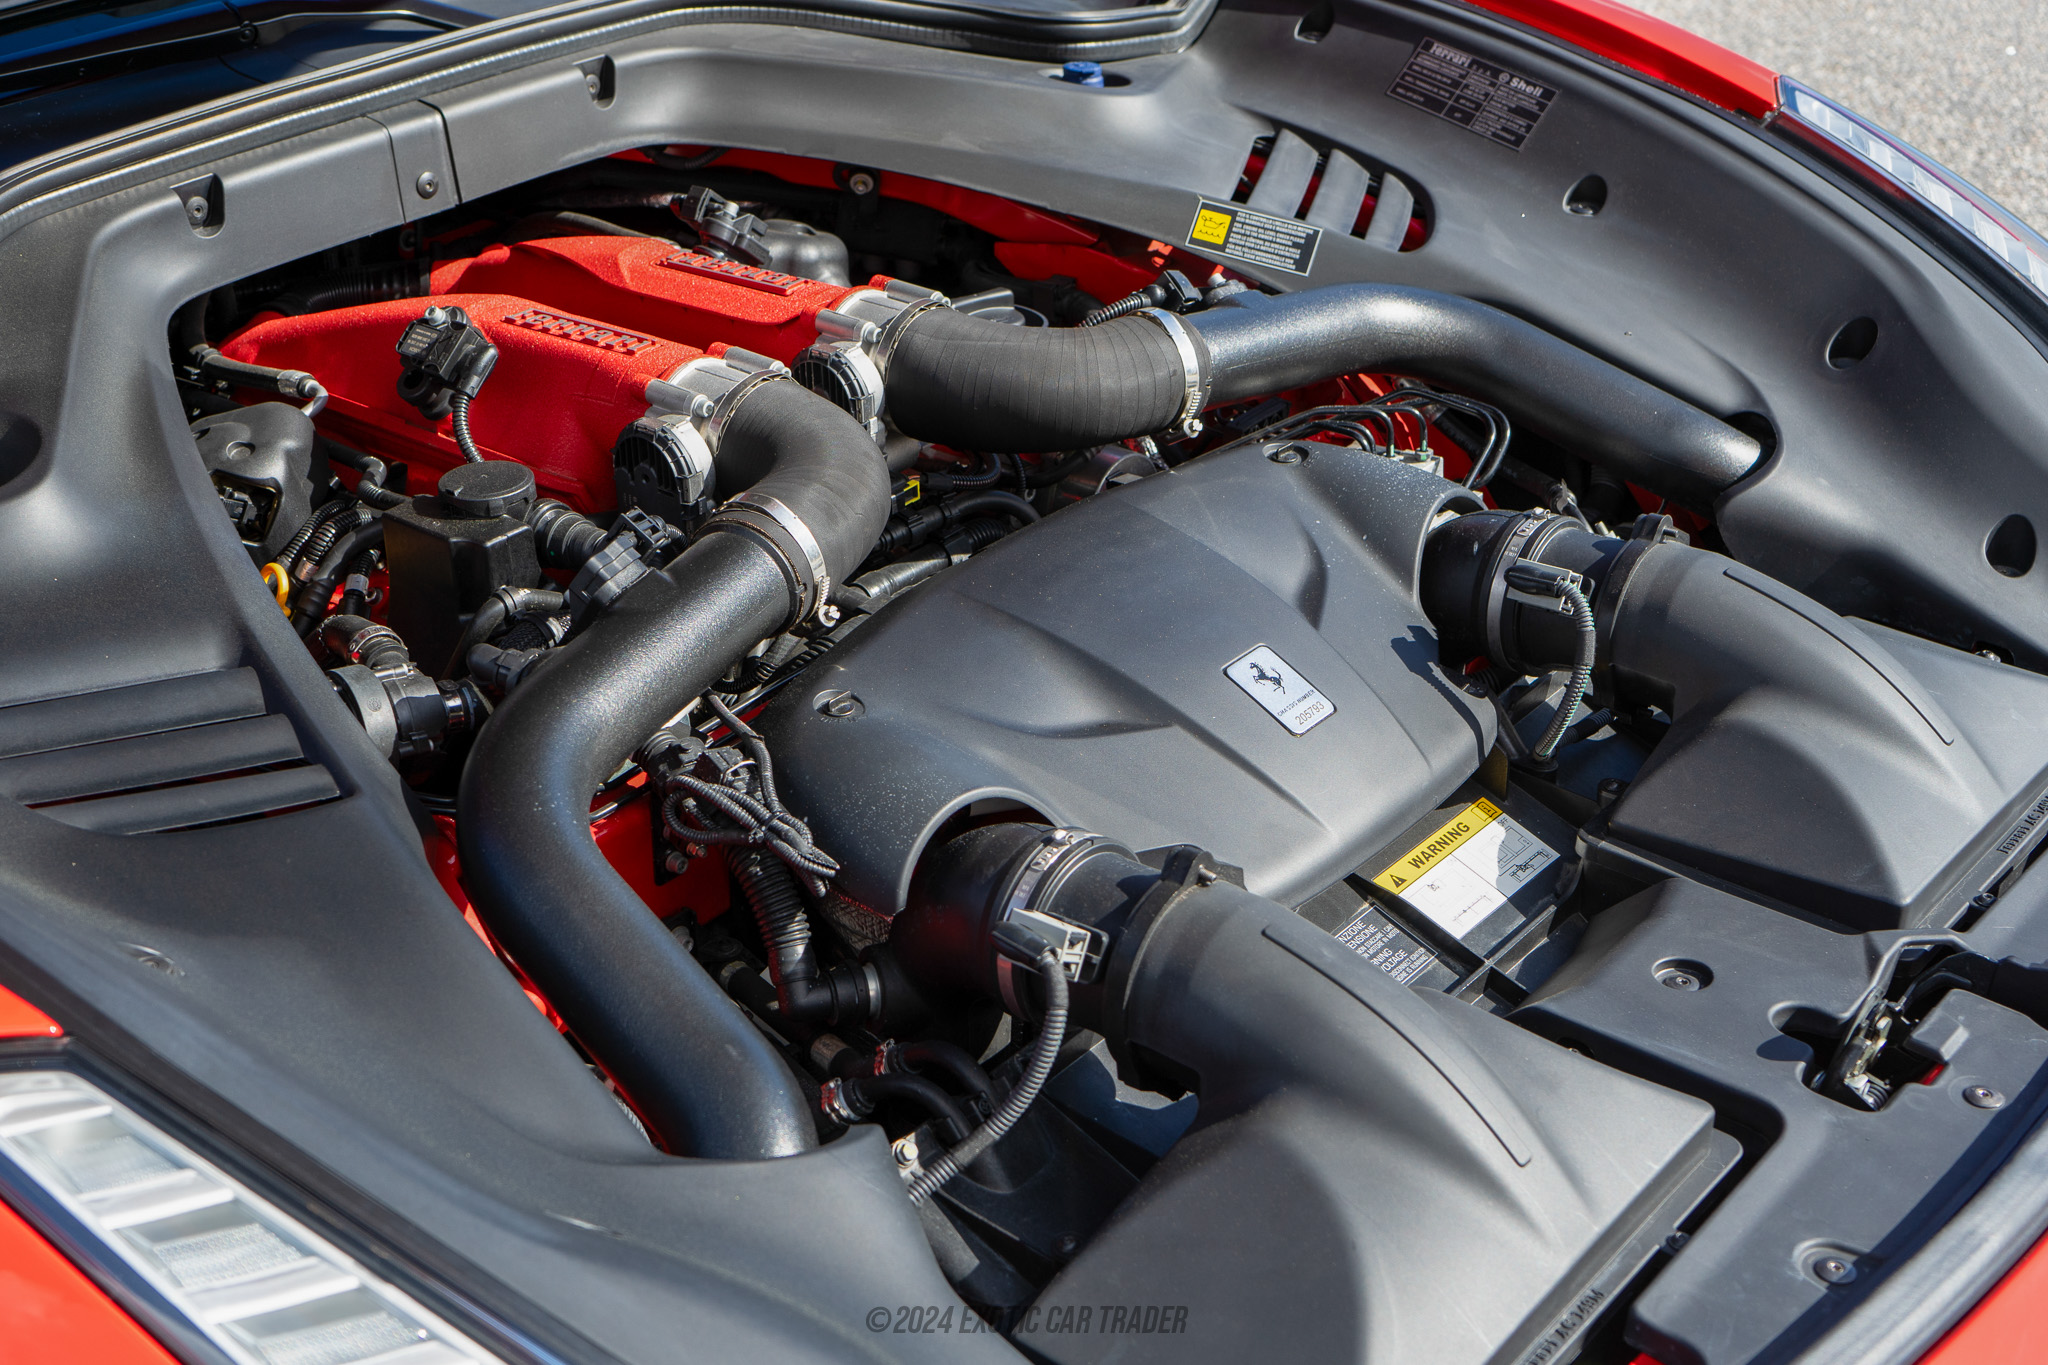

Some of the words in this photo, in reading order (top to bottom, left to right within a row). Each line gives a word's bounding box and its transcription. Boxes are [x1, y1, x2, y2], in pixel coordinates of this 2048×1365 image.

[1429, 41, 1473, 67] Ferrari
[1509, 77, 1544, 97] Shell
[504, 308, 656, 356] Ferrari
[1277, 701, 1299, 717] CHASSIS
[1296, 689, 1316, 703] NUMBER
[1295, 701, 1325, 725] 205793
[1407, 822, 1470, 869] WARNING
[1337, 920, 1366, 943] NZIONE
[1346, 924, 1378, 949] ENSIONE
